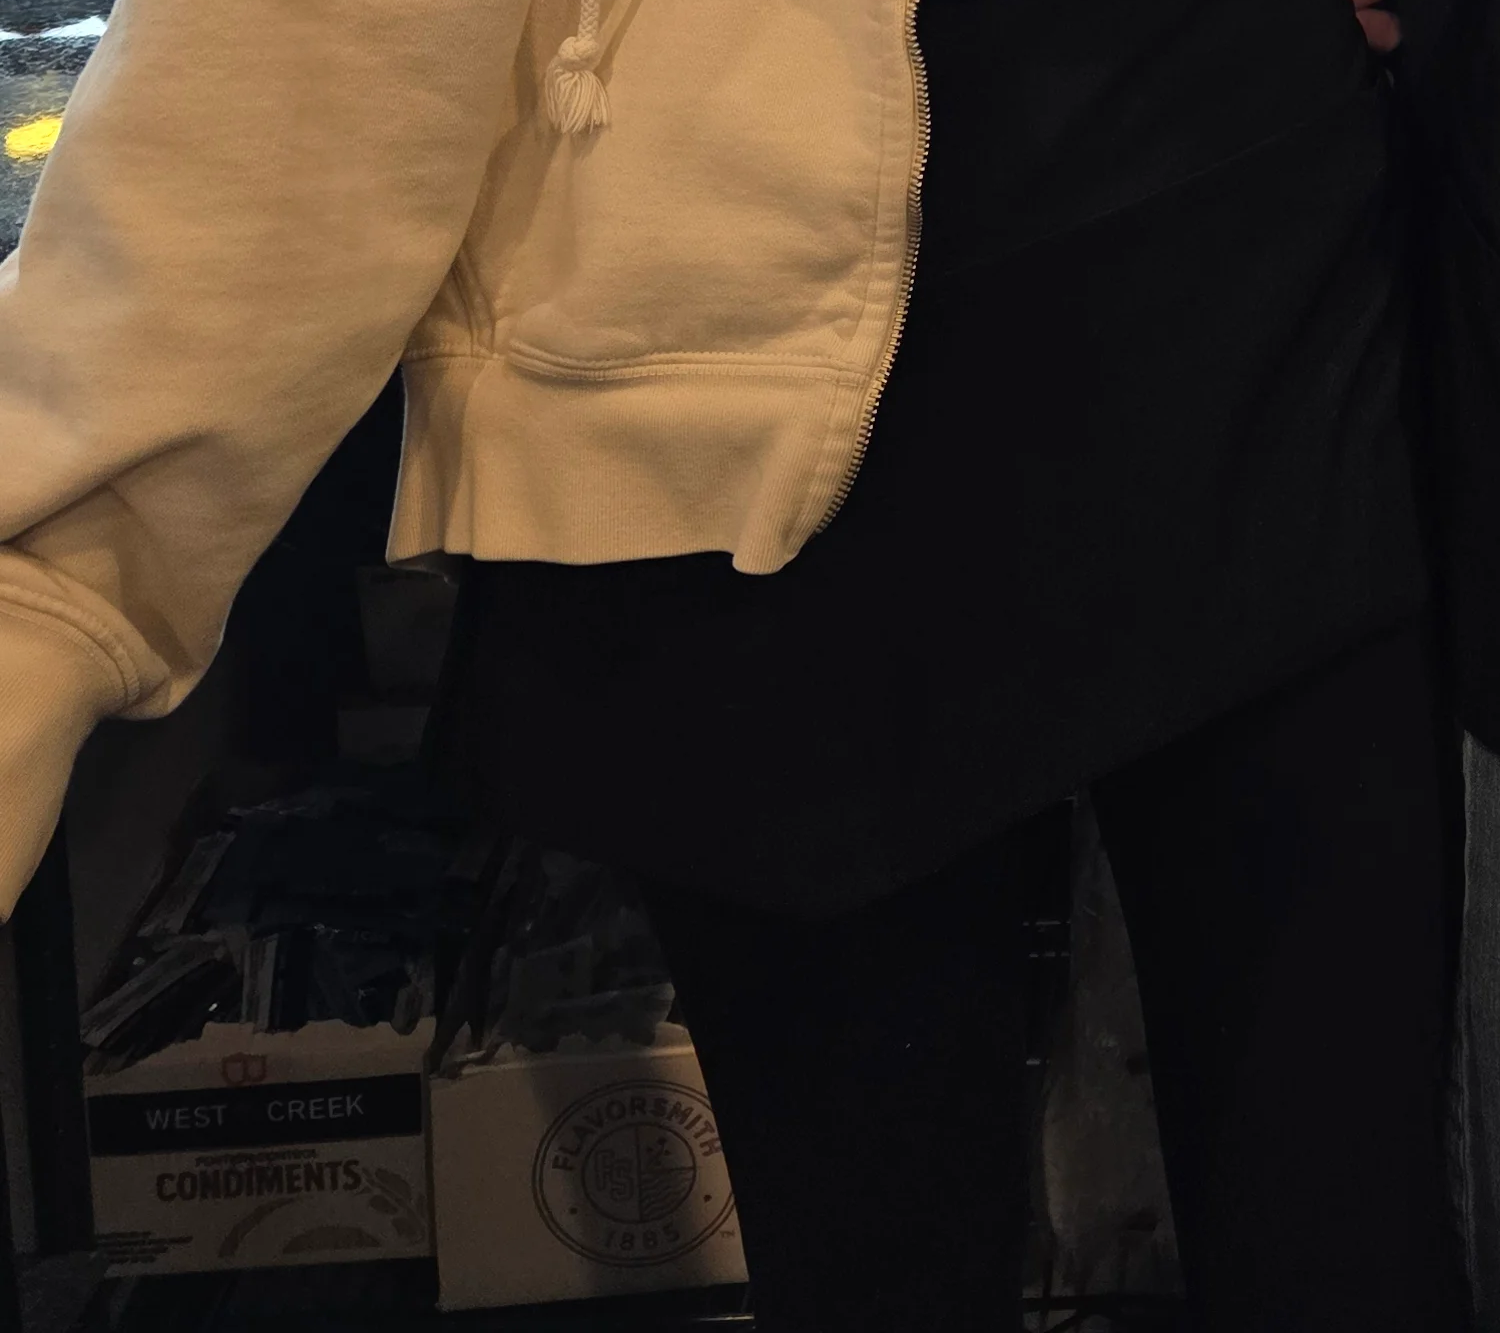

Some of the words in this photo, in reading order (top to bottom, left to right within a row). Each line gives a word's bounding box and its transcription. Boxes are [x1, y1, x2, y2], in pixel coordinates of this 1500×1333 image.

[145, 1104, 228, 1131] WEST
[267, 1095, 365, 1123] CREEK
[155, 1160, 362, 1202] CONDIMENTS
